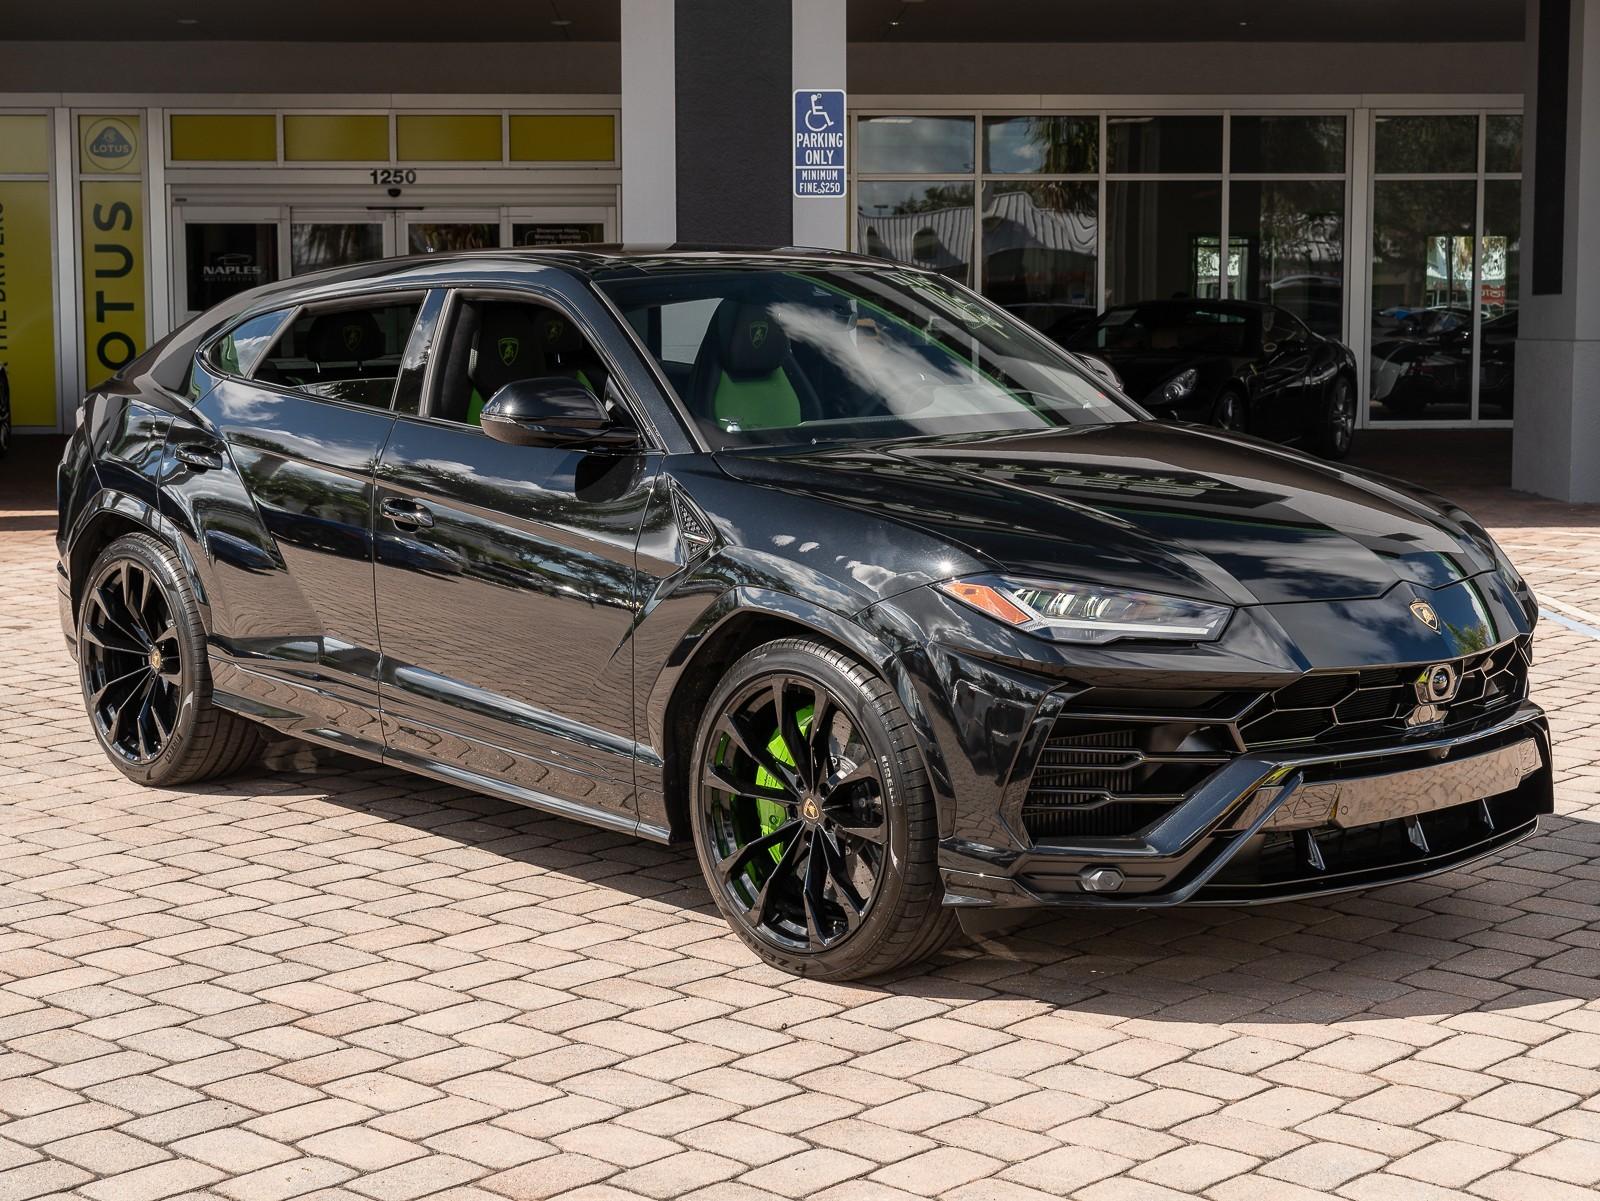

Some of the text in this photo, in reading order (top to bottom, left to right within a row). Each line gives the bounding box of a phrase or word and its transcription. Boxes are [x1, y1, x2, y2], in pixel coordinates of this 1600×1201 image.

[796, 132, 843, 148] PARKING
[93, 144, 129, 153] LOTUS
[805, 150, 834, 165] ONLY
[370, 169, 417, 184] 1250
[801, 169, 838, 181] MINIMUM
[799, 181, 841, 194] FINE $250
[203, 266, 262, 275] NAPLES
[93, 201, 137, 371] OTUS
